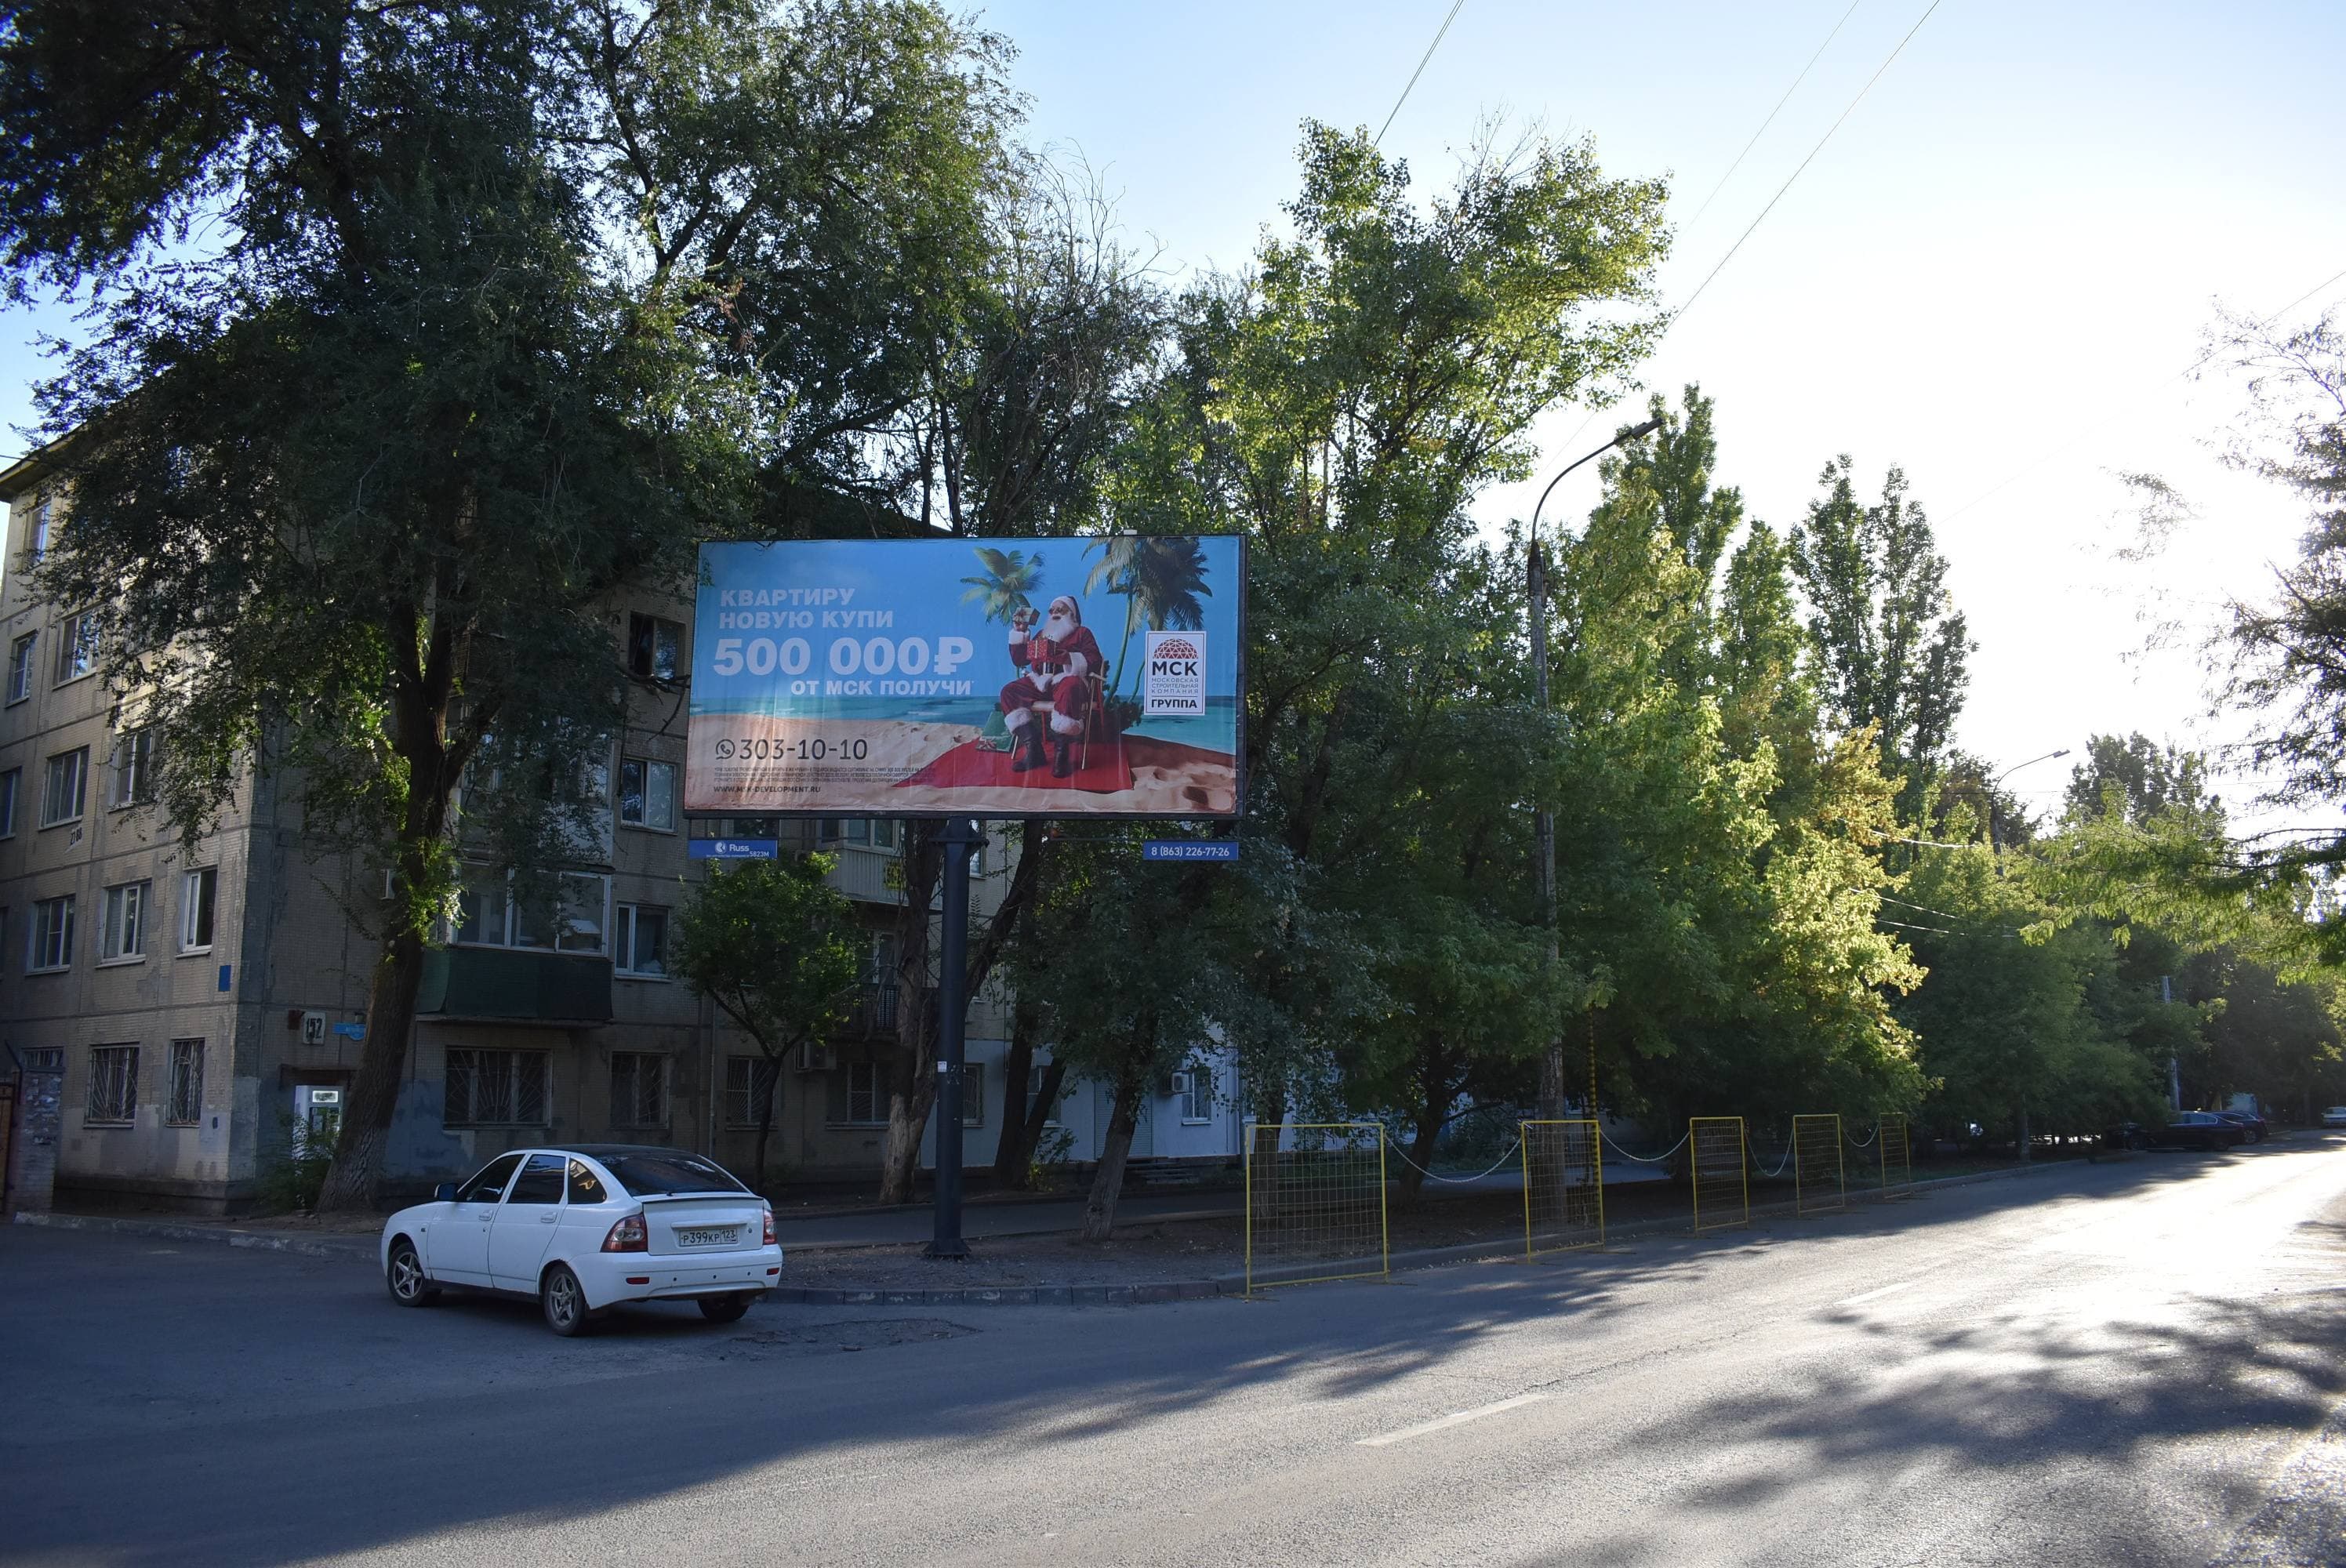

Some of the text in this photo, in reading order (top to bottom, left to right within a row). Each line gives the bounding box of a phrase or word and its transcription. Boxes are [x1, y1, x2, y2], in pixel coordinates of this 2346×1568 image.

[720, 588, 855, 607] КВАРТИРУ
[719, 610, 893, 629] НОВУЮ КУПИ
[714, 637, 811, 676] 500
[1152, 661, 1198, 677] МСК
[790, 680, 819, 695] ОТ
[826, 680, 873, 695] МСК
[1151, 699, 1198, 709] ГРУППА
[739, 739, 867, 760] 303-10-10
[1151, 846, 1229, 857] 8 (863) 226-77-26
